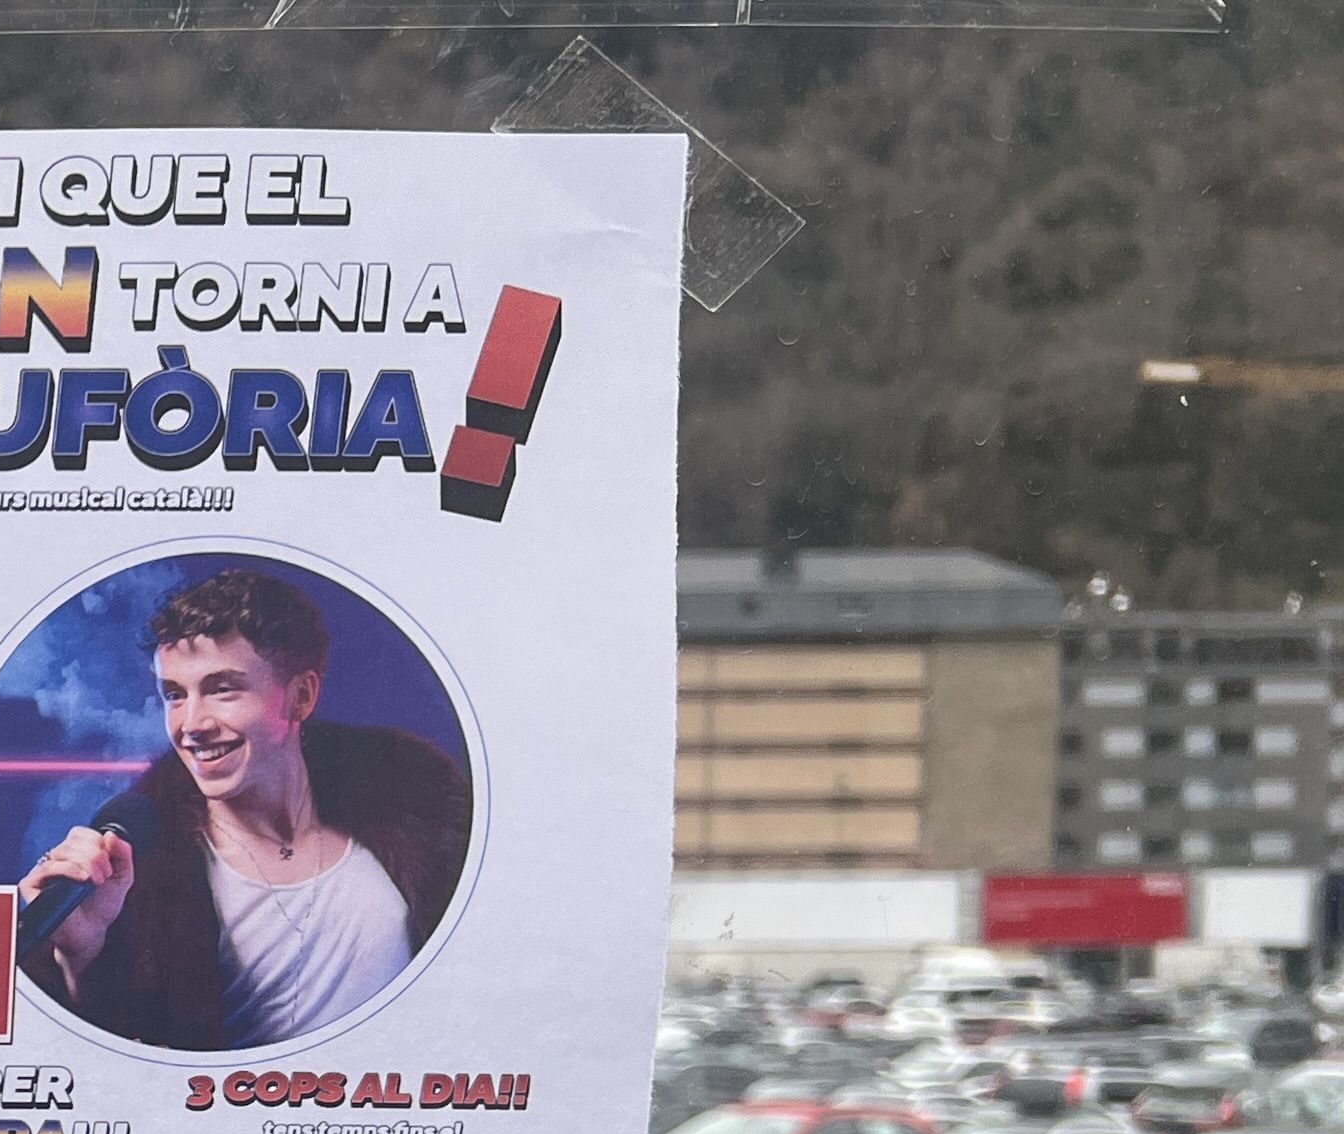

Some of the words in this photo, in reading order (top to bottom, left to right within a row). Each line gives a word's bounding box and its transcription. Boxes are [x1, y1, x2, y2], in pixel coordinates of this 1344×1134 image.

[39, 154, 229, 227] QUE
[244, 154, 351, 227] EL
[119, 261, 390, 333] TORNI
[403, 262, 467, 334] A
[28, 486, 126, 512] musical
[126, 486, 235, 512] català!!!
[185, 1075, 216, 1111] 3
[223, 1070, 347, 1108] COPS
[351, 1072, 413, 1109] AL
[419, 1072, 531, 1111] DIA!!
